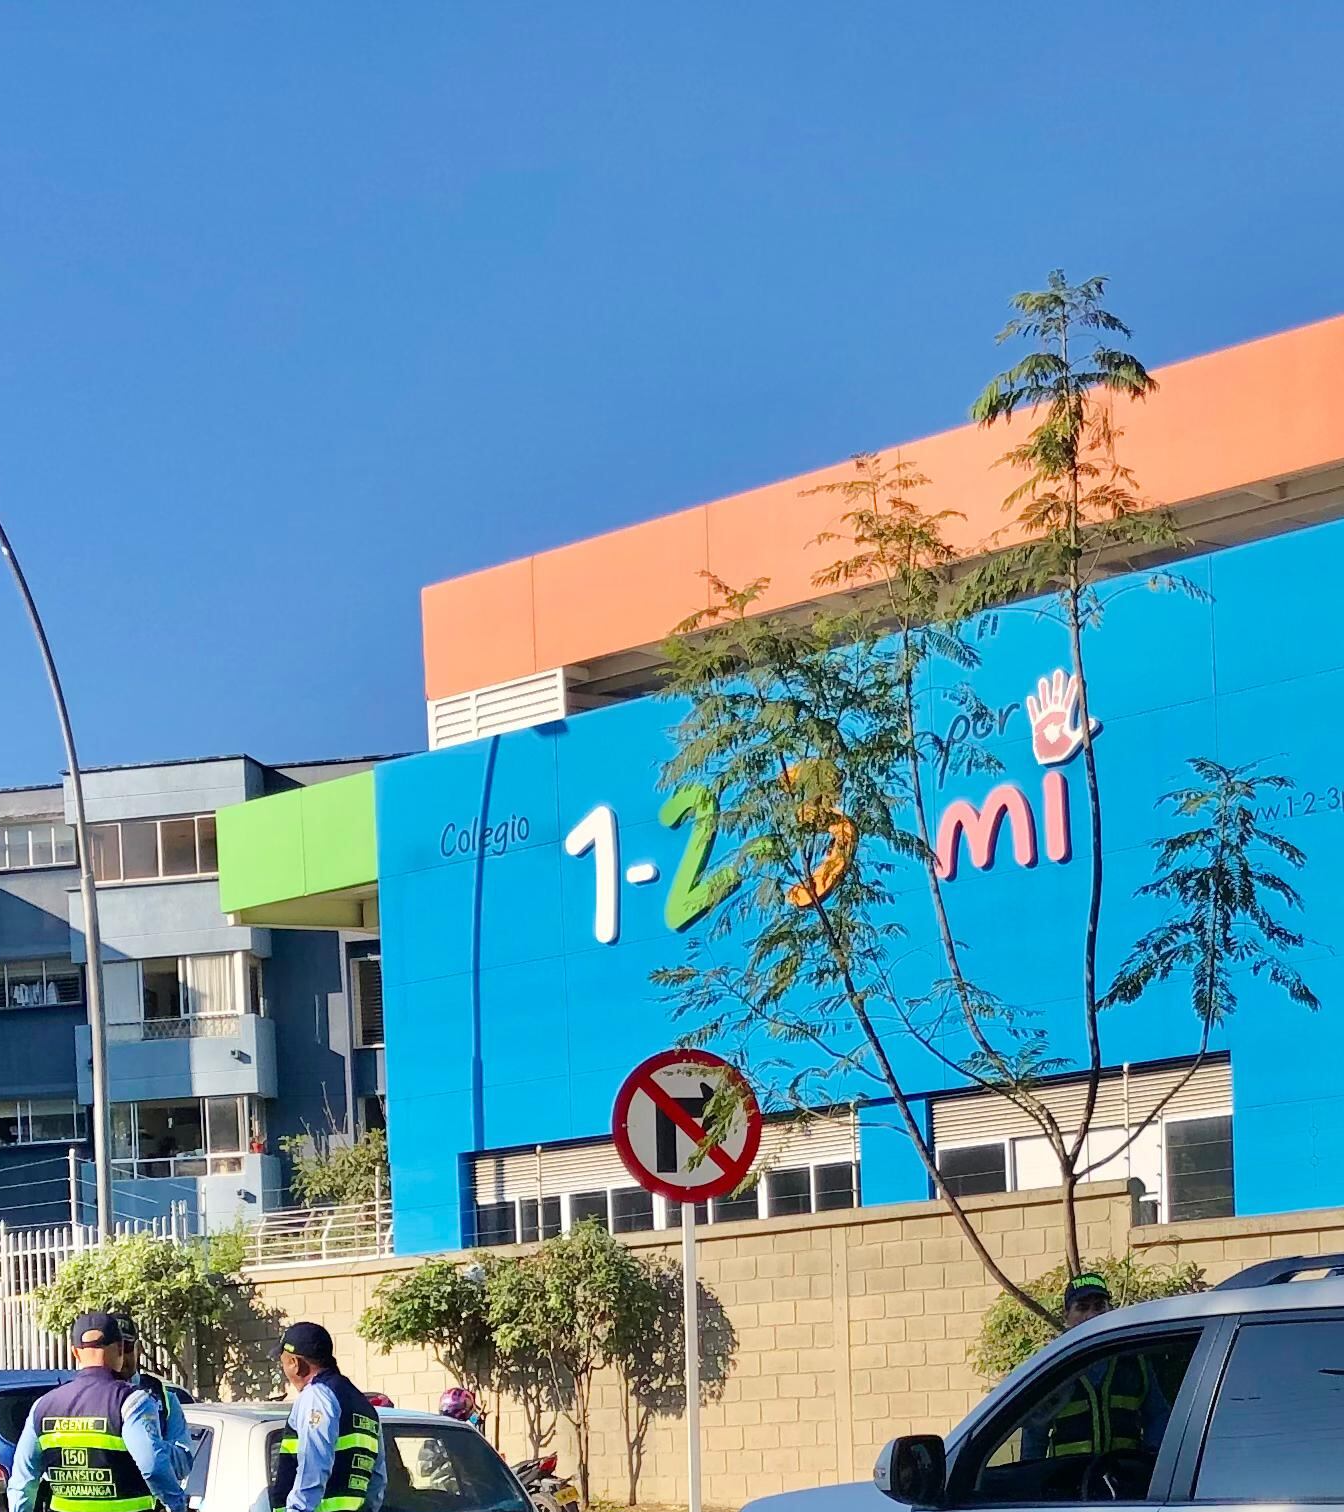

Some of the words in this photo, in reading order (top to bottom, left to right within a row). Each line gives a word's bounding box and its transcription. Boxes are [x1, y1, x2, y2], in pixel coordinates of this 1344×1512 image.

[938, 702, 1020, 790] por
[439, 812, 530, 858] Colegio
[935, 769, 1072, 882] mi
[53, 1419, 96, 1431] AGENTE
[63, 1449, 85, 1466] 150
[53, 1469, 105, 1482] TRANSITO
